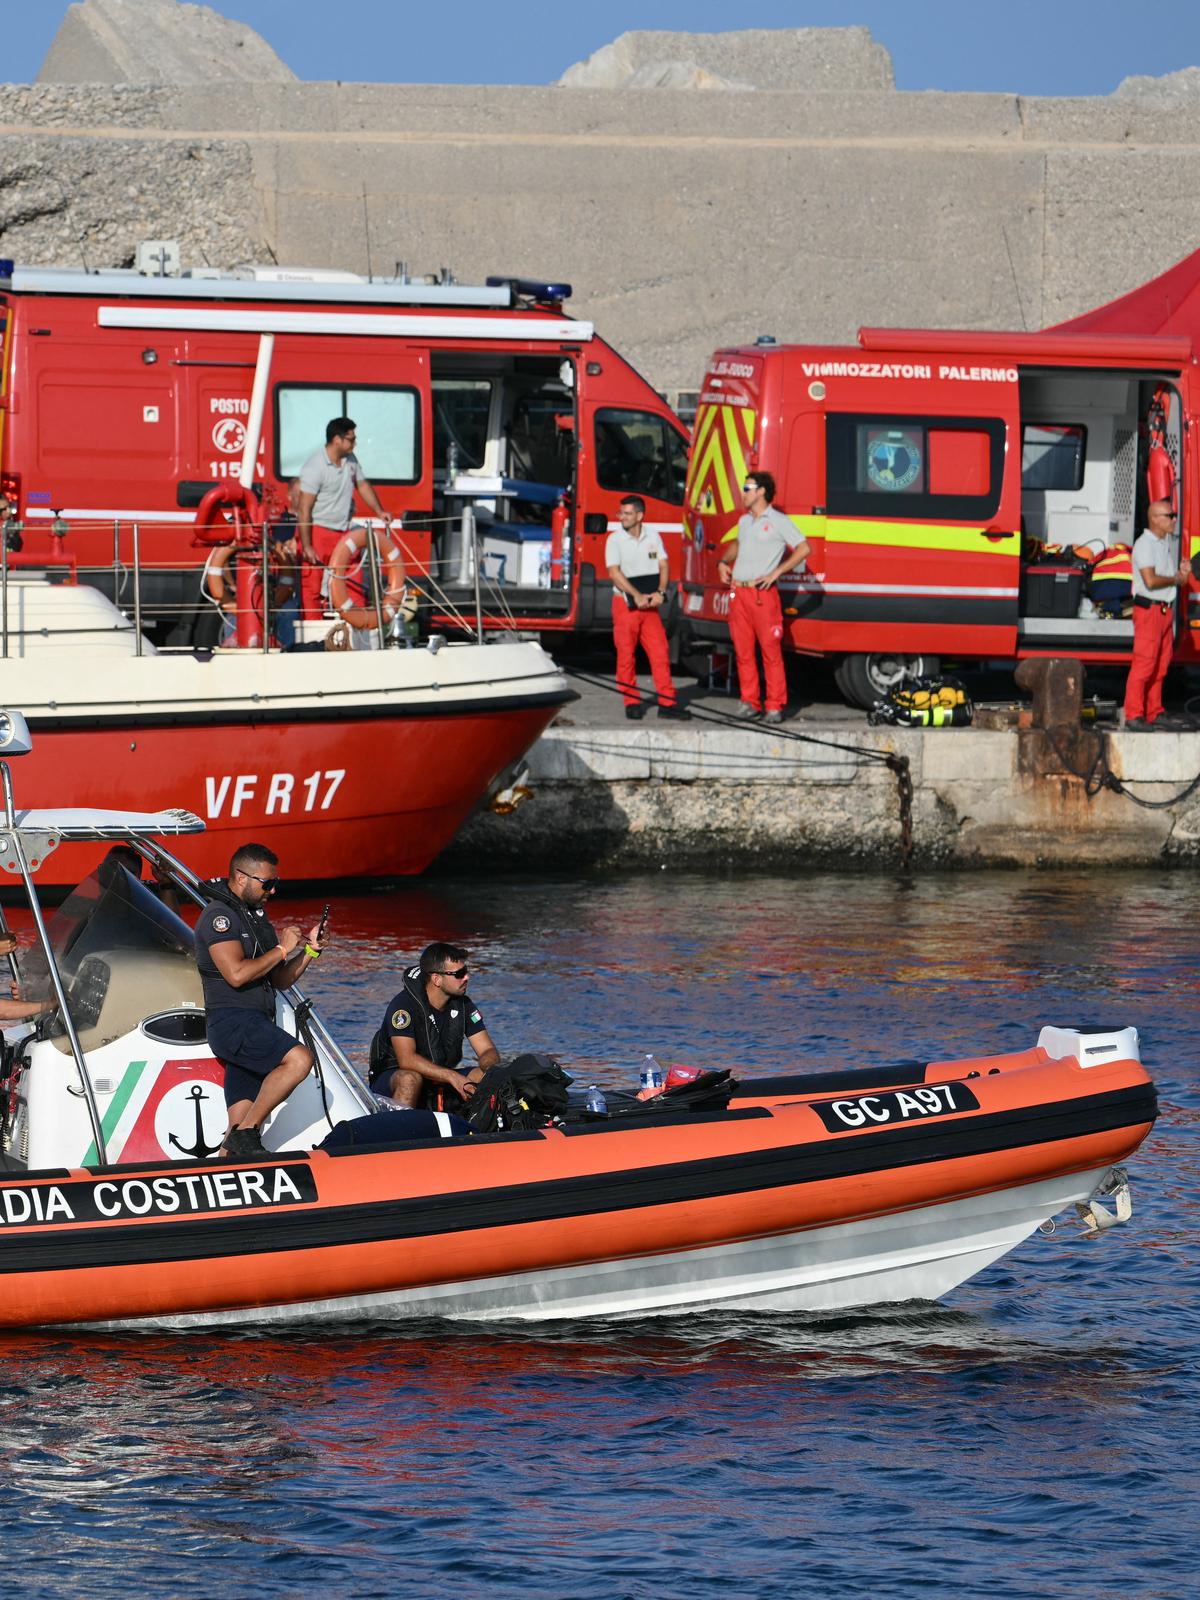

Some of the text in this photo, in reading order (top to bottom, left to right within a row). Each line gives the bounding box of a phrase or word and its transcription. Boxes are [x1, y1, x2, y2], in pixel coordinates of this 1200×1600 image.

[939, 366, 1019, 382] PALERMO
[210, 398, 249, 414] POSTO
[205, 769, 346, 819] VF R 17
[831, 1085, 957, 1127] GC A97
[93, 1168, 303, 1218] COSTIERA
